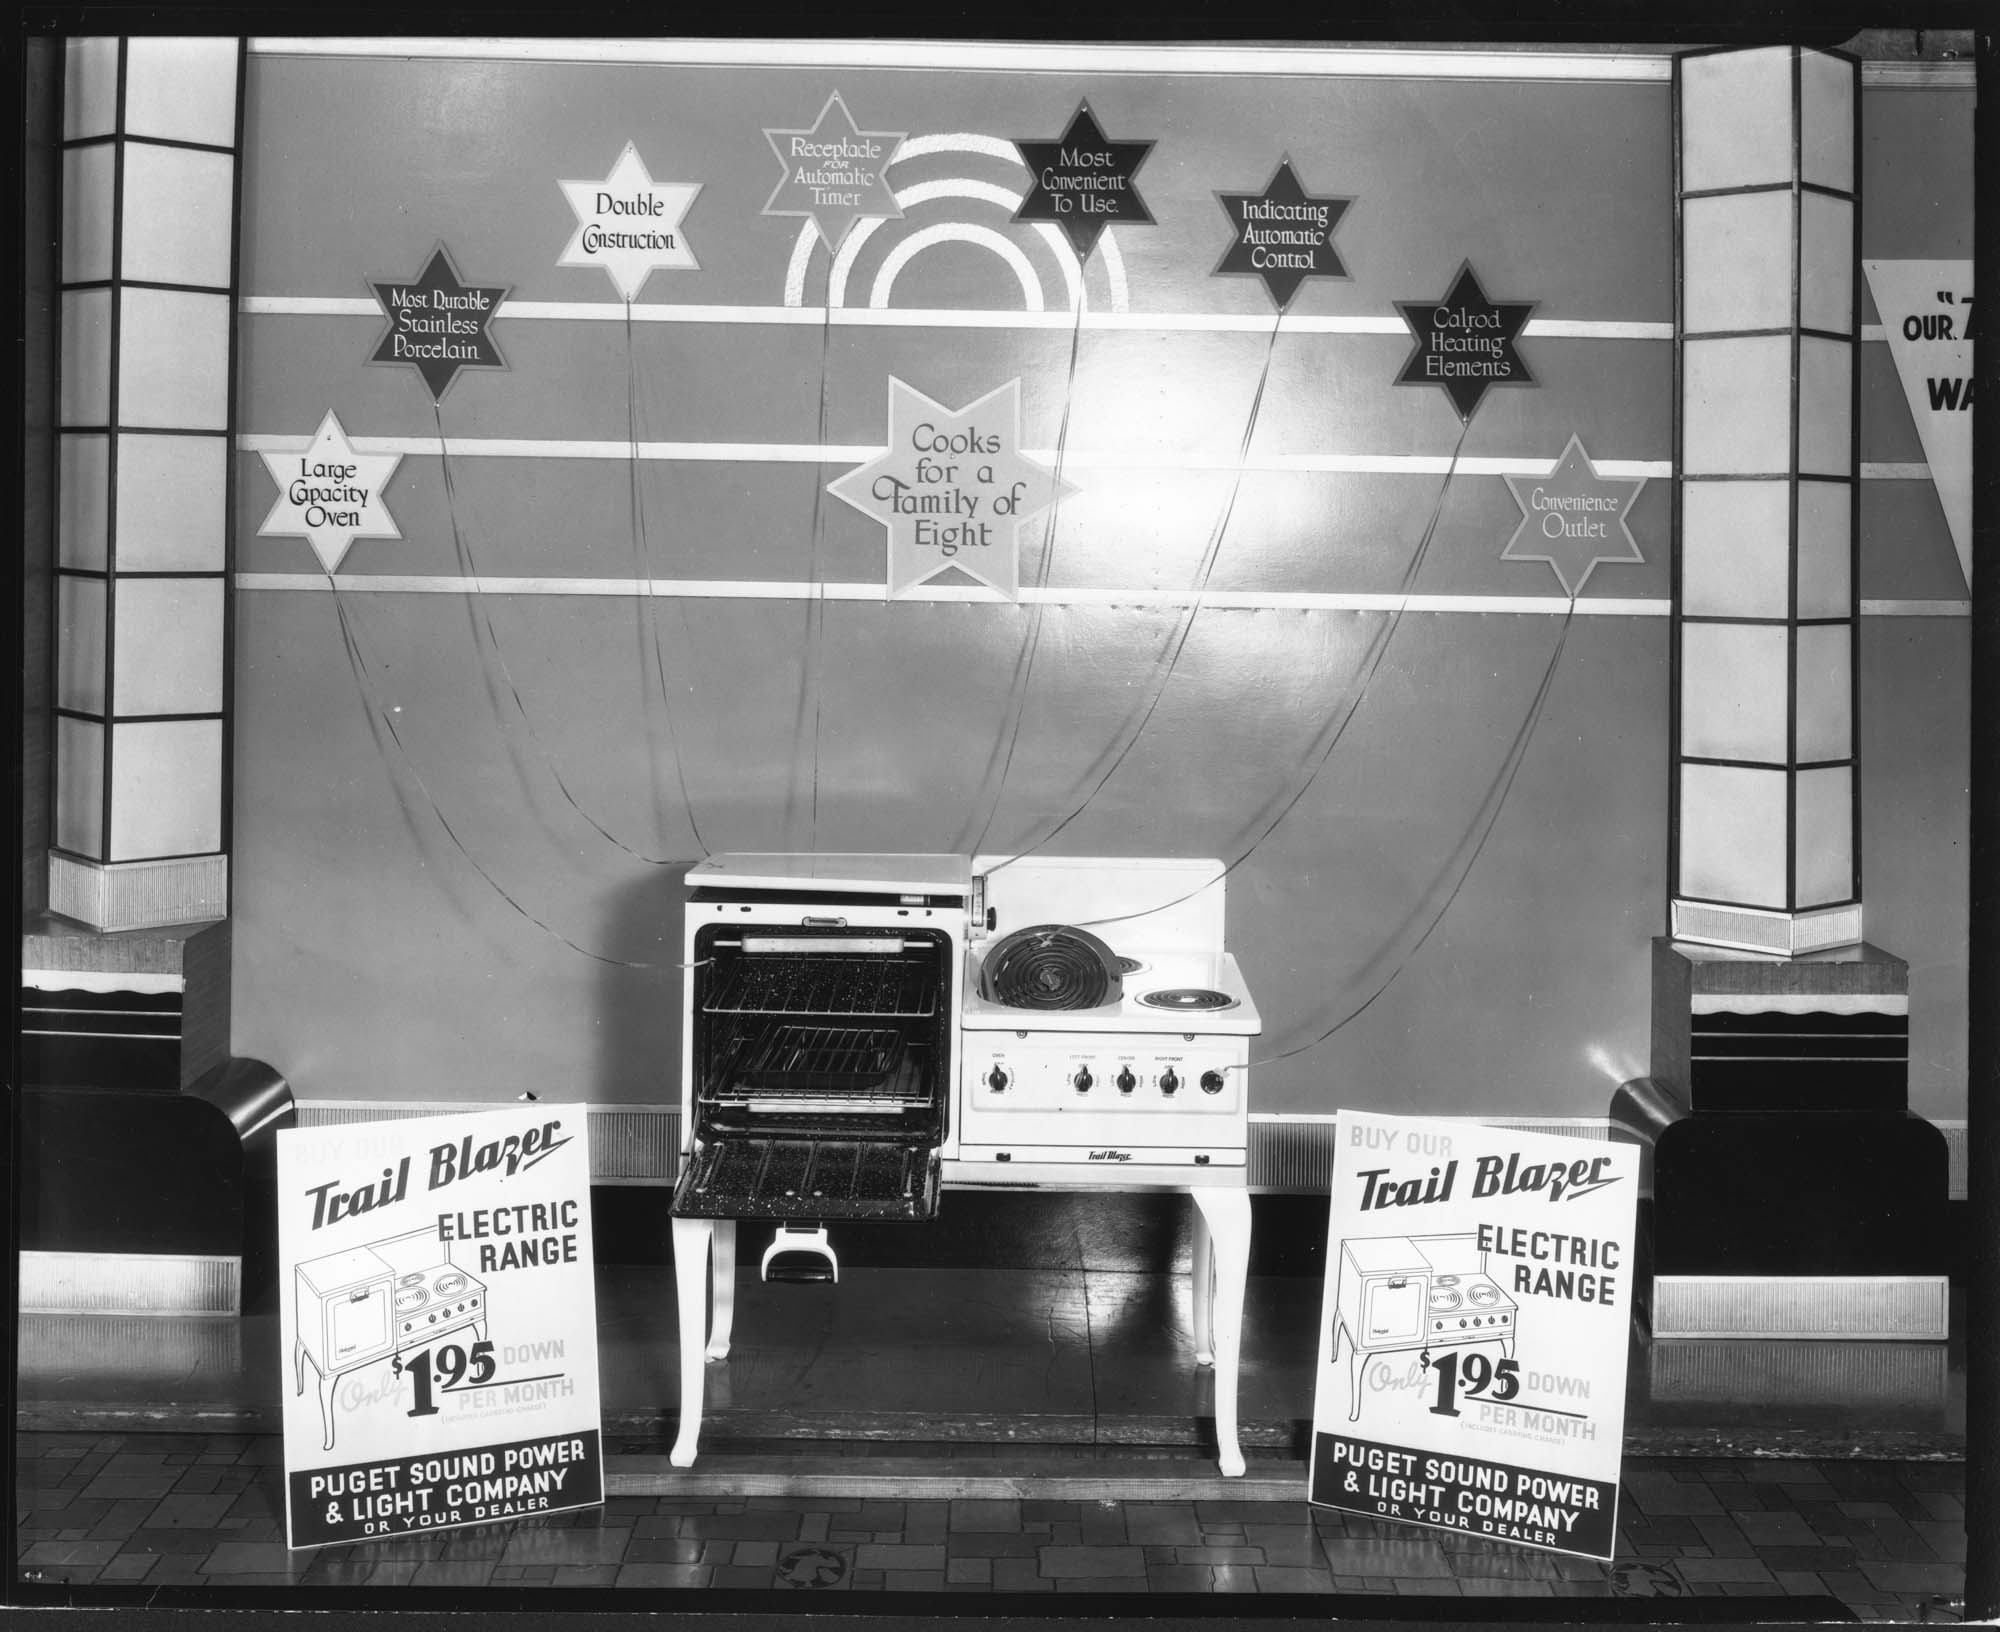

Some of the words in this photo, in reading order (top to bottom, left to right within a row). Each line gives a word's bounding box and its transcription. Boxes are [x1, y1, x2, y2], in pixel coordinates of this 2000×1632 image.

[790, 137, 881, 161] Receptacle
[1059, 148, 1115, 168] Most
[794, 167, 874, 187] Automatic
[1041, 170, 1126, 191] Convenient
[595, 192, 664, 218] Double
[809, 187, 862, 207] Timer
[1050, 194, 1074, 213] To
[1242, 200, 1328, 227] Indicating
[582, 224, 675, 254] Construction
[1242, 222, 1324, 246] Automatic
[1251, 246, 1316, 270] Control
[391, 287, 429, 309] Most
[433, 289, 490, 311] Durable
[398, 308, 478, 335] Stainless
[1433, 307, 1502, 330] Calrod
[393, 334, 480, 360] Porcelain
[1430, 332, 1505, 358] Heating
[1425, 356, 1511, 378] Elements
[912, 422, 1001, 455] Cooks
[300, 457, 357, 484] Large
[915, 456, 958, 484] for
[976, 464, 994, 484] a
[289, 479, 368, 508] Capacity
[872, 475, 980, 518] Family
[992, 481, 1026, 516] of
[1531, 487, 1618, 514] Convenience
[305, 505, 360, 528] Oven
[1542, 513, 1607, 539] Outlet
[913, 519, 993, 556] Eight
[1350, 1125, 1399, 1152] BUY
[1406, 1132, 1453, 1158] OUR
[305, 1156, 411, 1230] Trail
[428, 1120, 574, 1191] Blazer
[1356, 1160, 1459, 1211] Trail
[1472, 1152, 1624, 1202] Blazer
[437, 1200, 578, 1242] ELECTRIC
[479, 1235, 578, 1273] RANGE
[1476, 1223, 1620, 1270] ELECTRIC
[1514, 1264, 1615, 1306] RANGE
[340, 1368, 408, 1413] Only
[503, 1339, 565, 1366] DOWN
[1368, 1359, 1432, 1400] Only
[1527, 1370, 1591, 1399] DOWN
[458, 1389, 497, 1411] PER
[504, 1377, 575, 1406] MONTH
[1479, 1404, 1517, 1427] PER
[1523, 1410, 1597, 1441] MONTH
[310, 1466, 400, 1498] PUGET
[409, 1452, 494, 1486] SOUND
[504, 1439, 584, 1472] POWER
[1333, 1440, 1417, 1475] PUGET
[1425, 1457, 1508, 1492] SOUND
[1517, 1476, 1600, 1511] POWER
[325, 1501, 344, 1524] &
[353, 1487, 433, 1522] LIGHT
[446, 1468, 568, 1507] COMPANY
[1343, 1470, 1361, 1493] &
[1368, 1475, 1446, 1512] LIGHT
[1457, 1491, 1580, 1533] COMPANY
[364, 1519, 390, 1535] OR
[403, 1510, 462, 1529] YOUR
[475, 1496, 549, 1519] DEALER
[1377, 1500, 1401, 1516] OR
[1414, 1507, 1470, 1528] YOUR
[1483, 1521, 1557, 1545] DEALER
